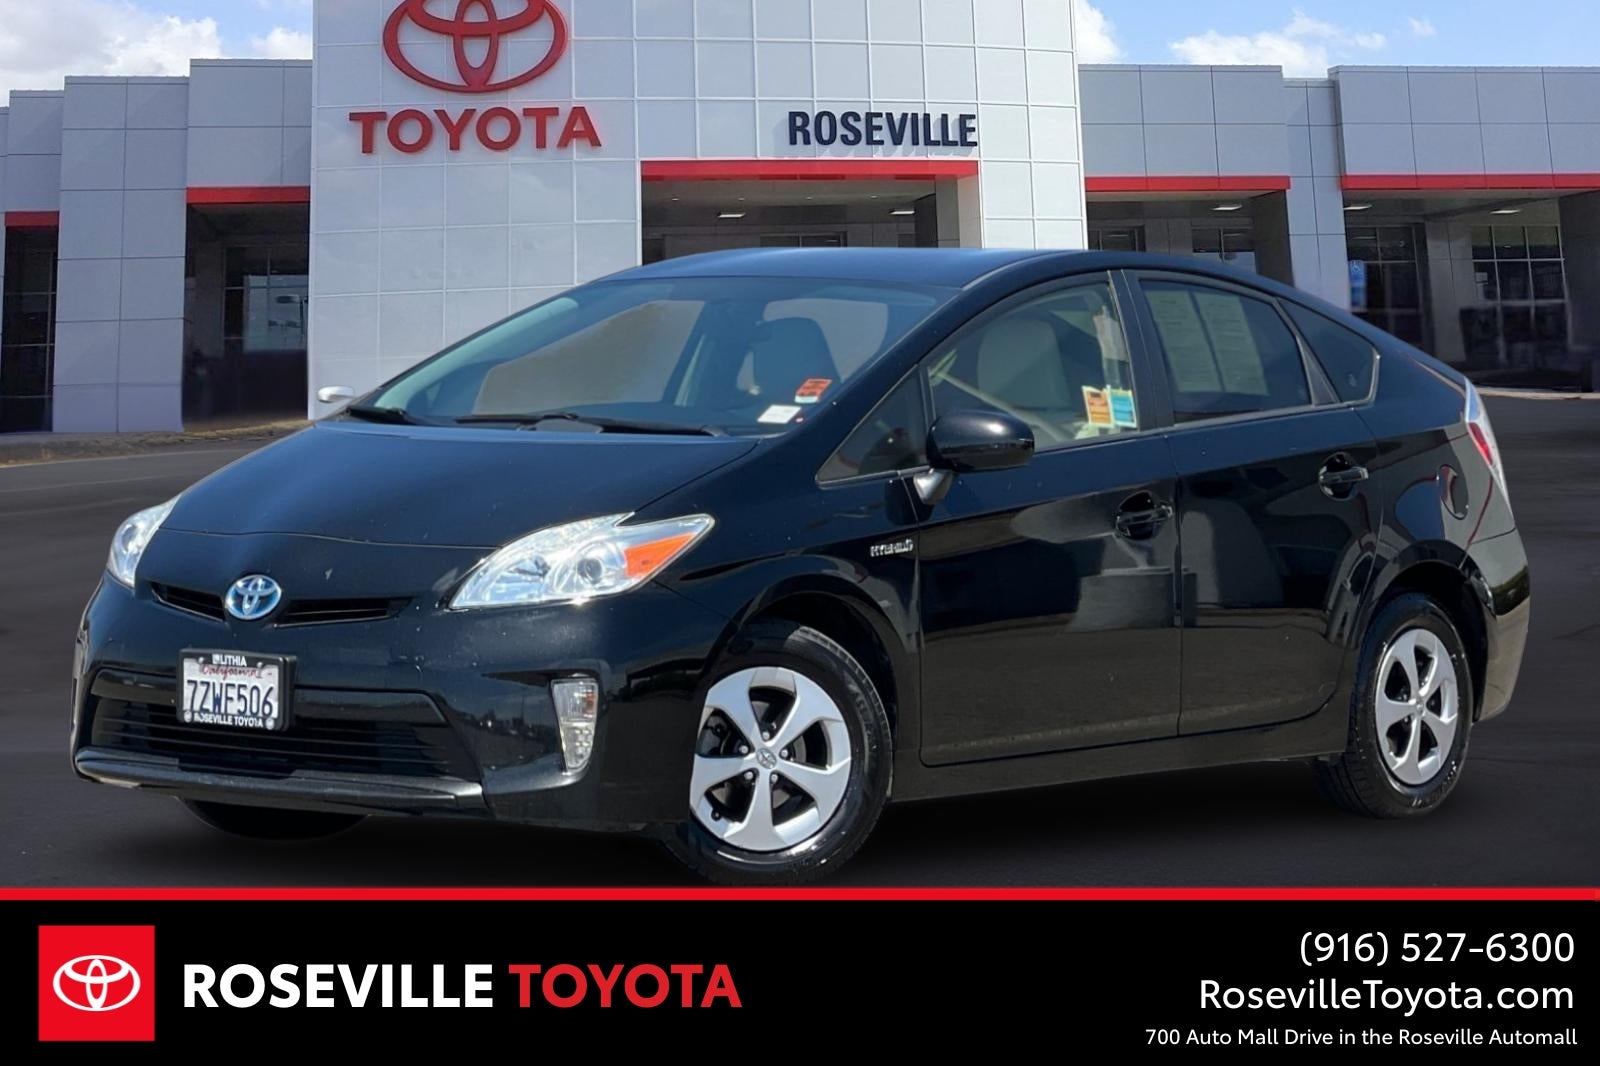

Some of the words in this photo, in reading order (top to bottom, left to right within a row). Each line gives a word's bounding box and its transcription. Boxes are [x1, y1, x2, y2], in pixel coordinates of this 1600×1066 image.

[349, 106, 602, 154] TOYOTA
[788, 111, 978, 147] ROSEVILLE
[220, 655, 248, 667] LITHIA
[187, 680, 274, 718] 7ZWF506
[193, 713, 233, 726] ROSEVILLE
[234, 716, 264, 728] TOYOTA
